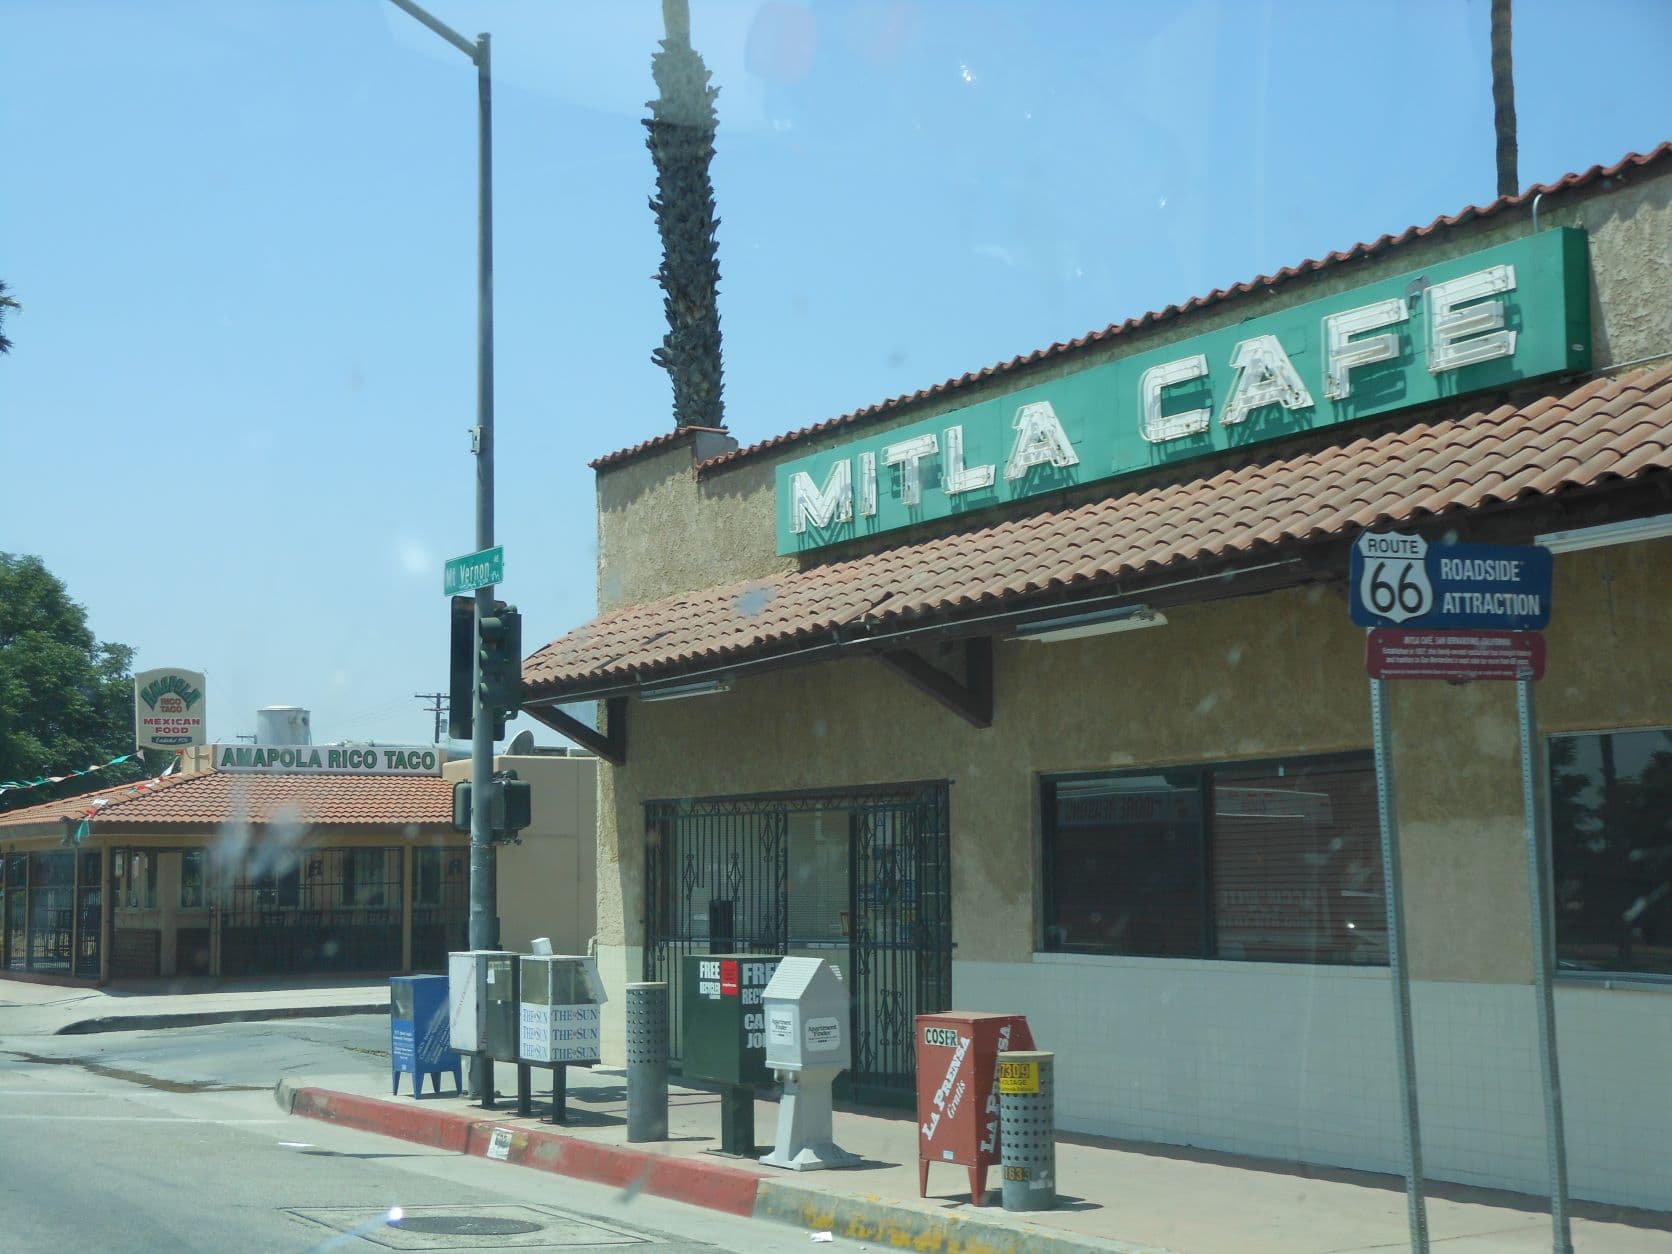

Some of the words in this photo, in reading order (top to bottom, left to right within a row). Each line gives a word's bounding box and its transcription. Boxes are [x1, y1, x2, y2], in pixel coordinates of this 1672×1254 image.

[789, 400, 1080, 534] MITLA
[1138, 264, 1517, 443] CAFE
[1367, 538, 1420, 554] ROUTE
[460, 562, 490, 585] Vernon
[1440, 558, 1521, 581] ROADSIDE
[1369, 561, 1423, 613] 66
[1442, 592, 1540, 616] ATTRACTION
[160, 697, 182, 705] RICO
[160, 705, 183, 713] TACO
[143, 718, 200, 726] MEXICAN
[154, 726, 189, 734] FOOD
[221, 747, 323, 768] AMAPOLA
[328, 750, 378, 769] RICO
[384, 751, 436, 770] TACO
[699, 961, 721, 979] FREE
[742, 988, 764, 1005] RECY
[523, 1008, 534, 1022] THE
[552, 1010, 573, 1022] THE
[577, 1008, 598, 1021] SUN
[744, 1013, 765, 1030] CA
[523, 1025, 534, 1040] THE
[552, 1028, 573, 1041] THE
[577, 1027, 598, 1040] SUN
[807, 1024, 837, 1033] Apartment
[523, 1042, 534, 1057] THE
[552, 1047, 573, 1060] THE
[577, 1046, 598, 1059] SUN
[921, 1112, 941, 1141] LA
[933, 1036, 971, 1111] PRENSA
[980, 1120, 998, 1154] LA
